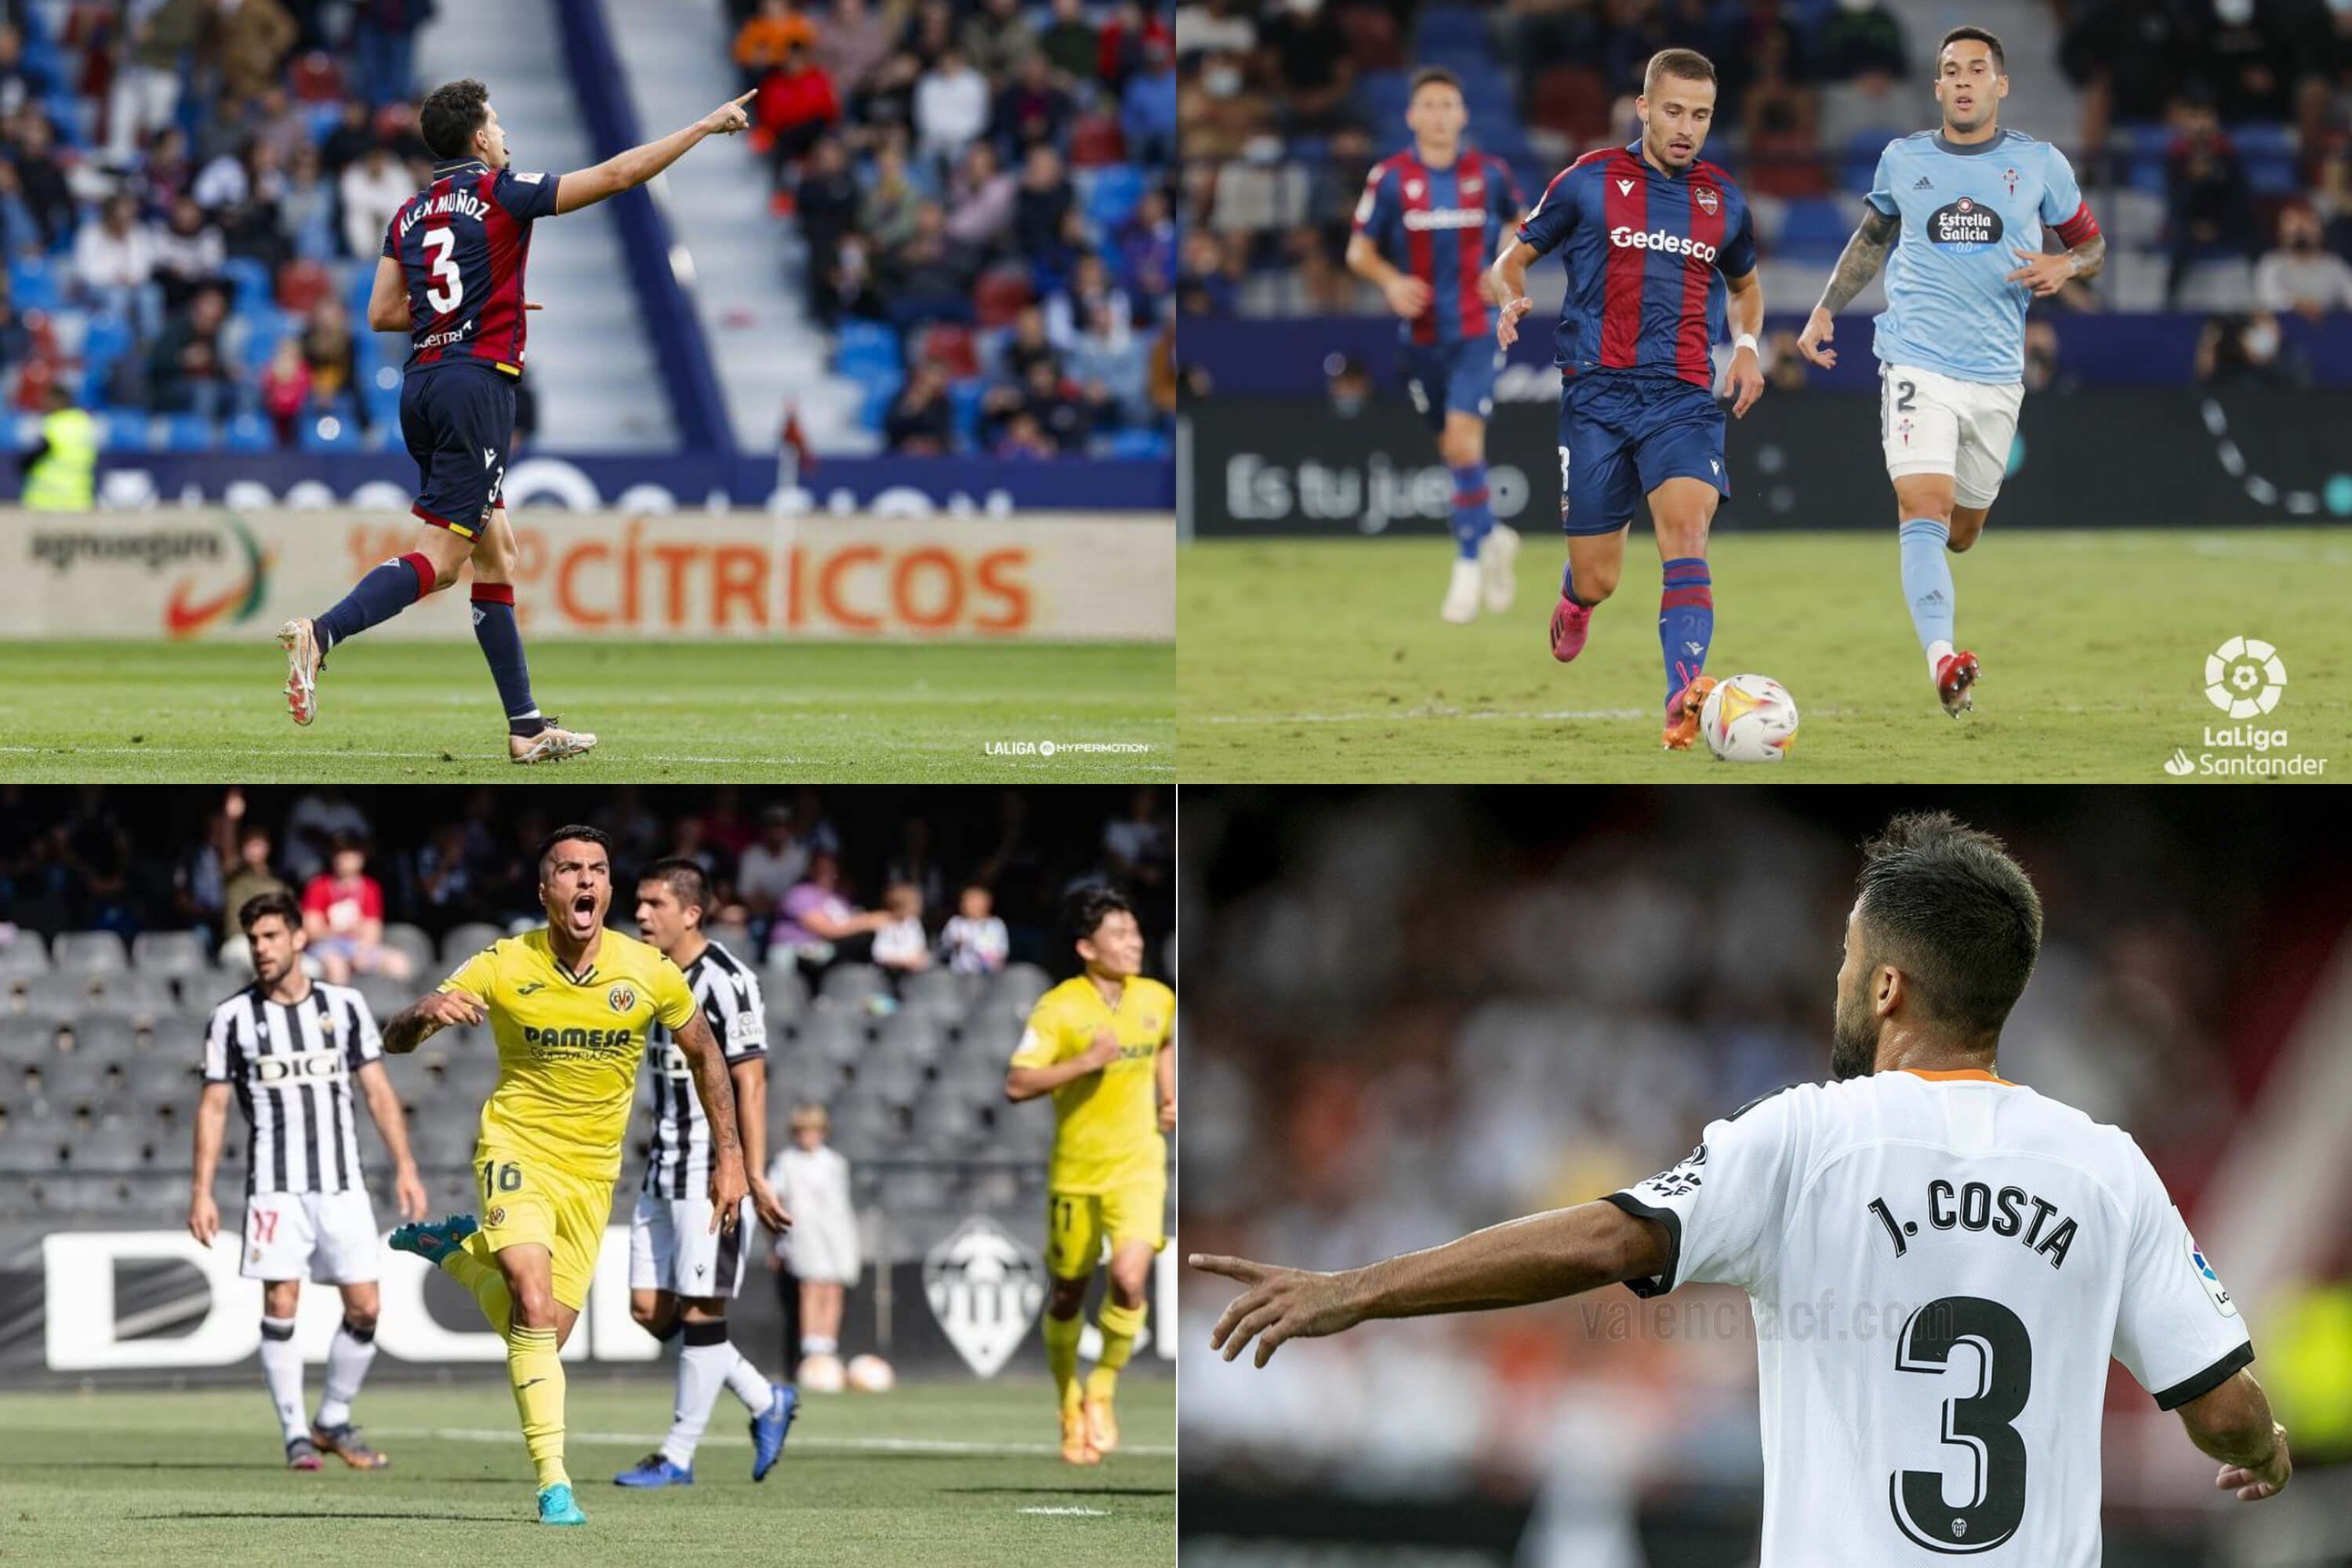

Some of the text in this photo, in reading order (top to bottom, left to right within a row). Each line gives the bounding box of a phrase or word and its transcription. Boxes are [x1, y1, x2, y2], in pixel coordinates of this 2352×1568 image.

[398, 187, 492, 238] ALEX MUÑOZ
[1938, 212, 1991, 227] Estrella
[1940, 227, 1989, 241] Galicia
[1610, 226, 1716, 263] Gedesco
[421, 227, 464, 314] 3
[1897, 380, 1916, 412] 2
[1358, 451, 1530, 535] jueo
[555, 519, 1033, 633] CÍTRICOS
[524, 1025, 632, 1047] PAMESA
[484, 1160, 521, 1199] 16
[1927, 1178, 2078, 1270] COSTA
[1889, 1295, 2032, 1555] 3
